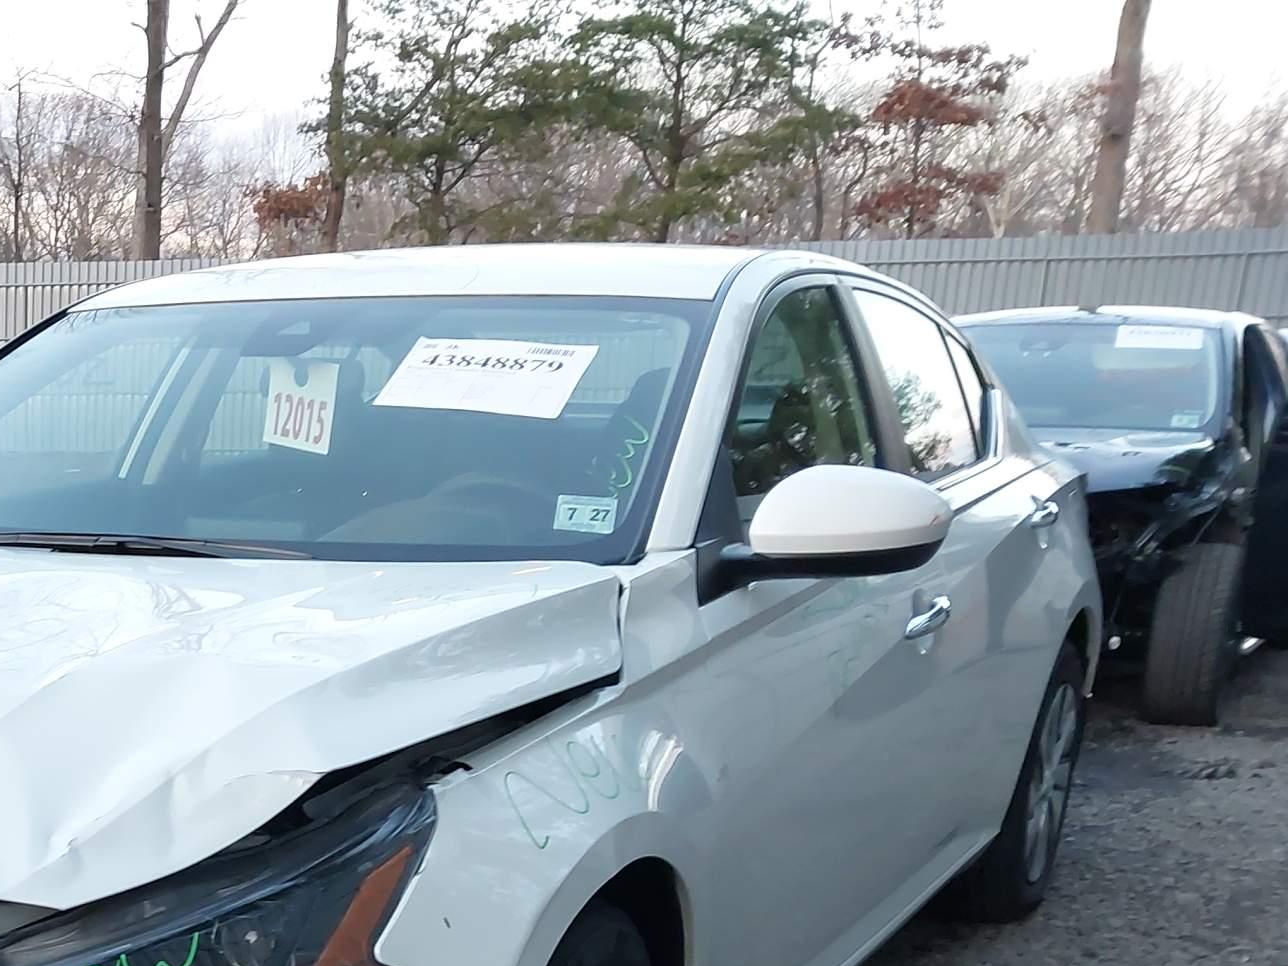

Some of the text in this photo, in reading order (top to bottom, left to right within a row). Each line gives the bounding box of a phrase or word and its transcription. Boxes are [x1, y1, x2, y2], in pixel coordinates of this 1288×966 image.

[422, 353, 564, 373] 43848879
[273, 391, 328, 445] 12015
[567, 507, 611, 522] 7 27
